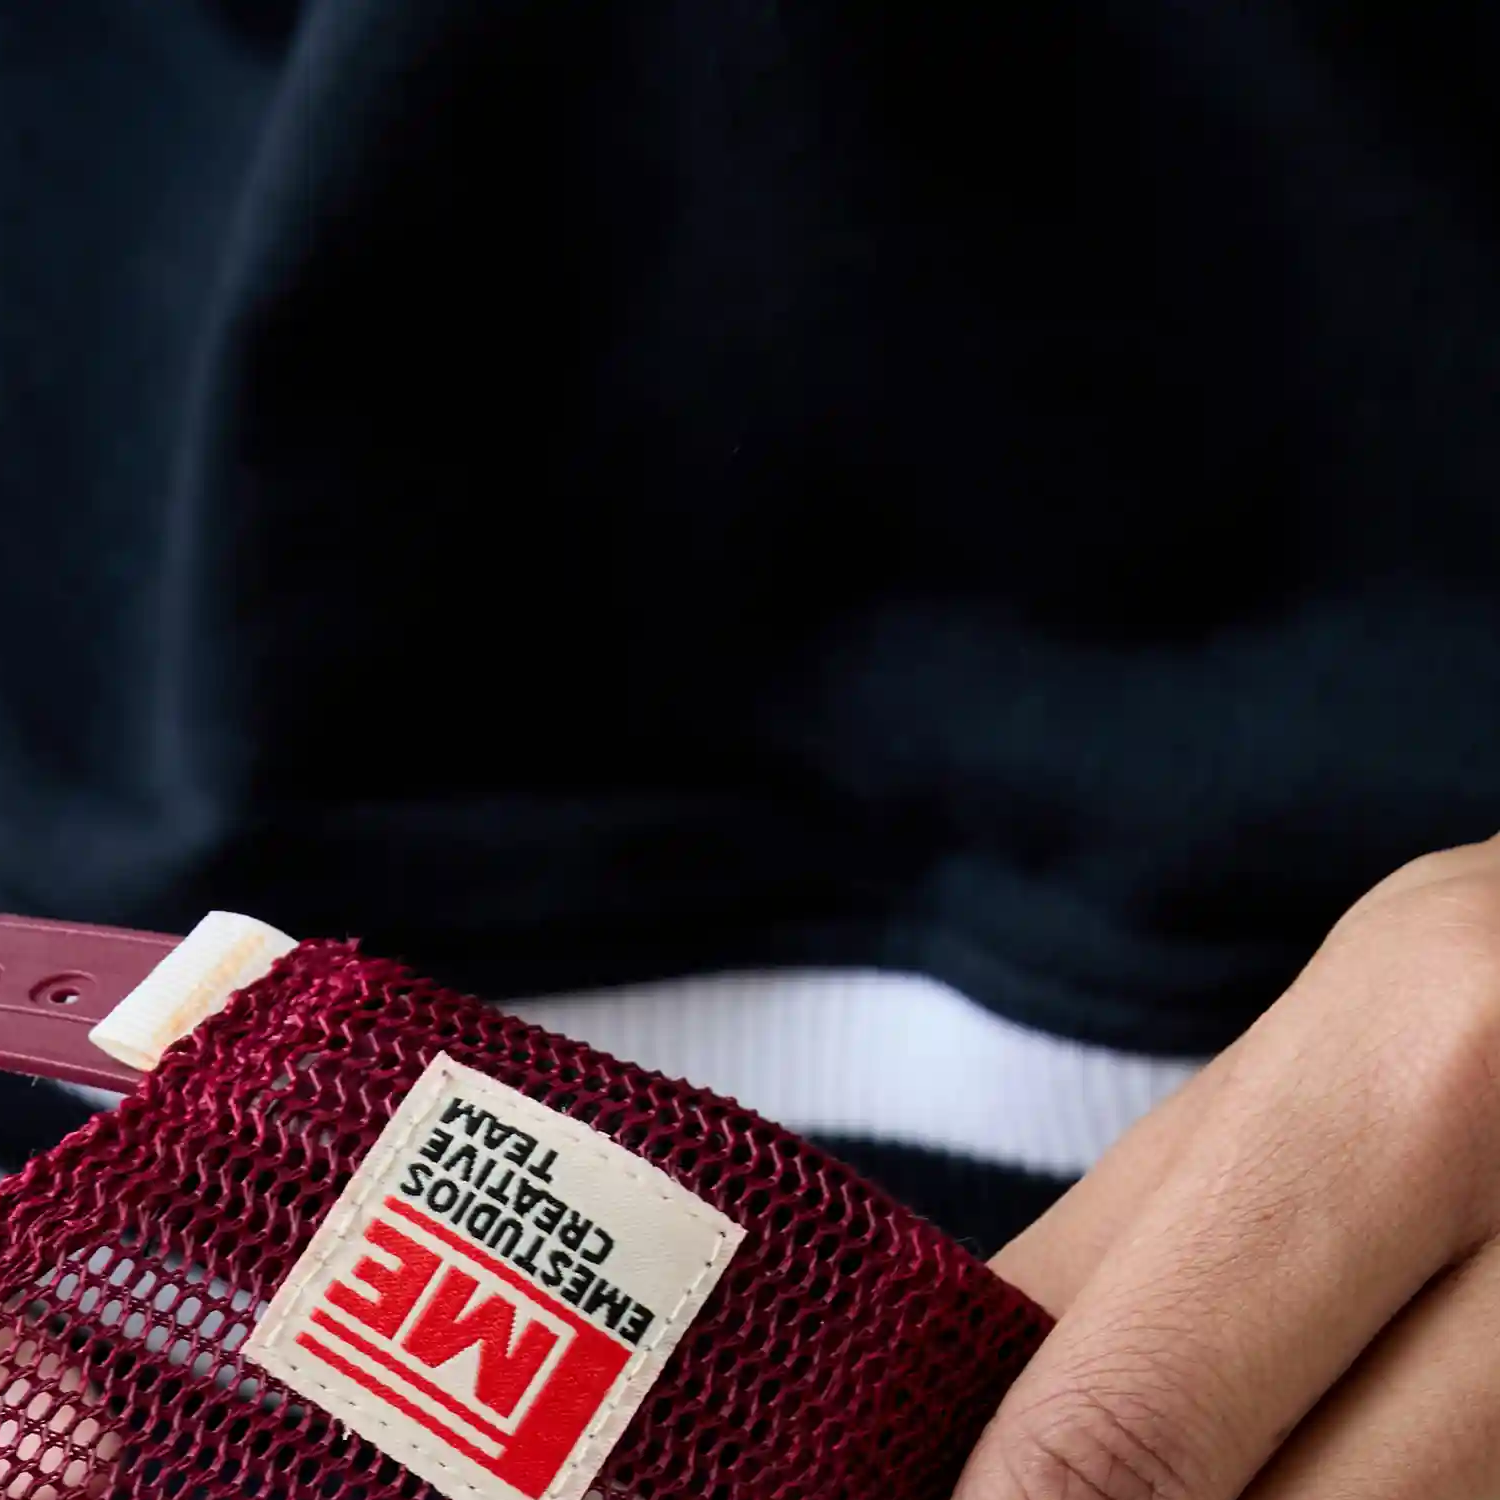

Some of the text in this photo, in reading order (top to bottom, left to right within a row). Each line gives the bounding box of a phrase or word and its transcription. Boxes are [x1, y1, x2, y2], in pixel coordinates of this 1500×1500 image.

[419, 1127, 615, 1266] CREATIVE
[439, 1097, 559, 1185] TEAM
[399, 1162, 656, 1347] EMESTUDIOS
